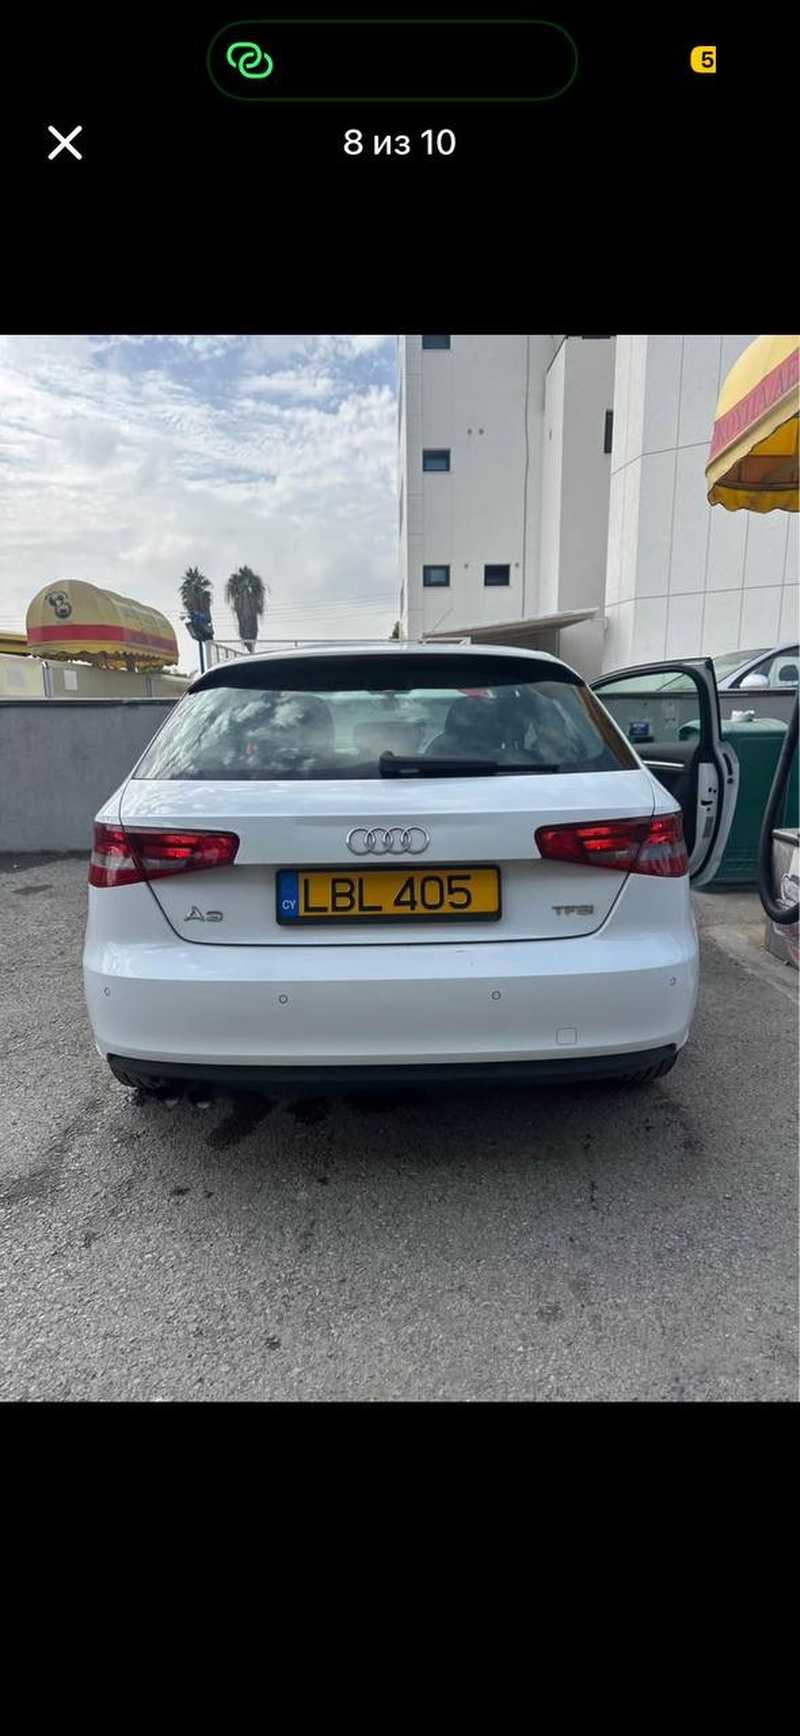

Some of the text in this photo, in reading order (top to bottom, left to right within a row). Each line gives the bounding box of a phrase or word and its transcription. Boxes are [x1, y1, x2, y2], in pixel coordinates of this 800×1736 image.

[303, 874, 472, 912] LBL 405
[281, 899, 297, 911] CY
[551, 904, 594, 916] TFSI
[183, 905, 224, 922] A3
